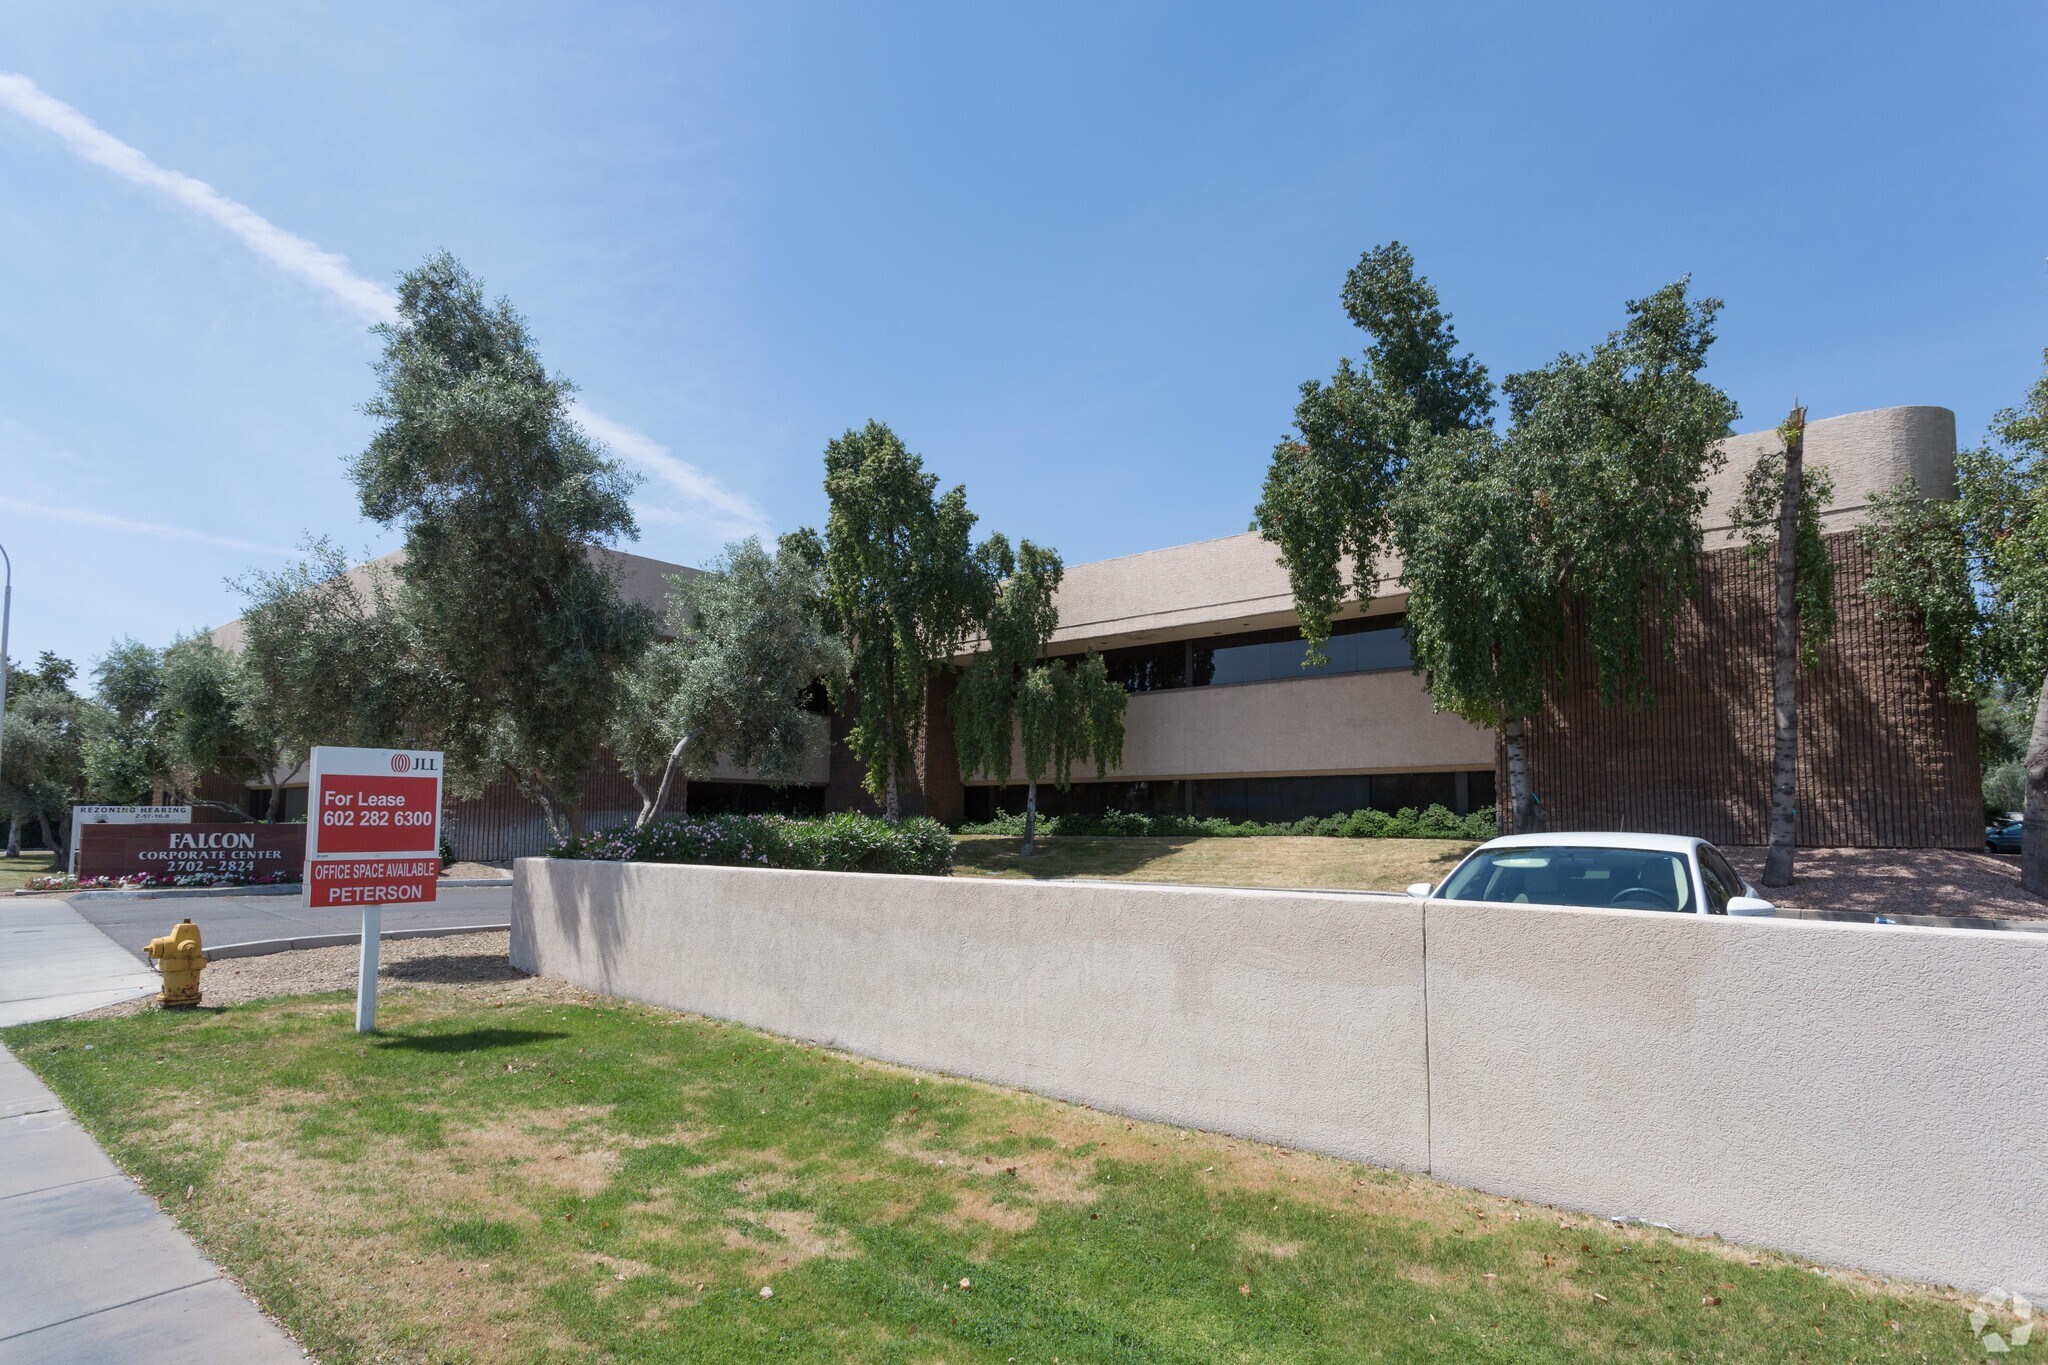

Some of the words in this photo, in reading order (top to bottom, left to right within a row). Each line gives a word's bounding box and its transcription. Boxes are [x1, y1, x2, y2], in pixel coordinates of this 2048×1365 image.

[411, 758, 438, 771] JLL
[324, 791, 354, 806] For
[358, 791, 406, 807] Lease
[323, 811, 355, 826] 602
[359, 811, 389, 826] 282
[394, 811, 432, 826] 6300
[169, 832, 256, 849] FALCON
[138, 851, 226, 860] CORPORATE
[231, 850, 282, 859] CENTER
[167, 861, 204, 872] 2702
[219, 860, 255, 872] 2824
[315, 864, 351, 880] OFFICE
[352, 863, 384, 879] SPACE
[385, 862, 435, 878] AVAILABLE
[328, 885, 423, 903] PETERSON
